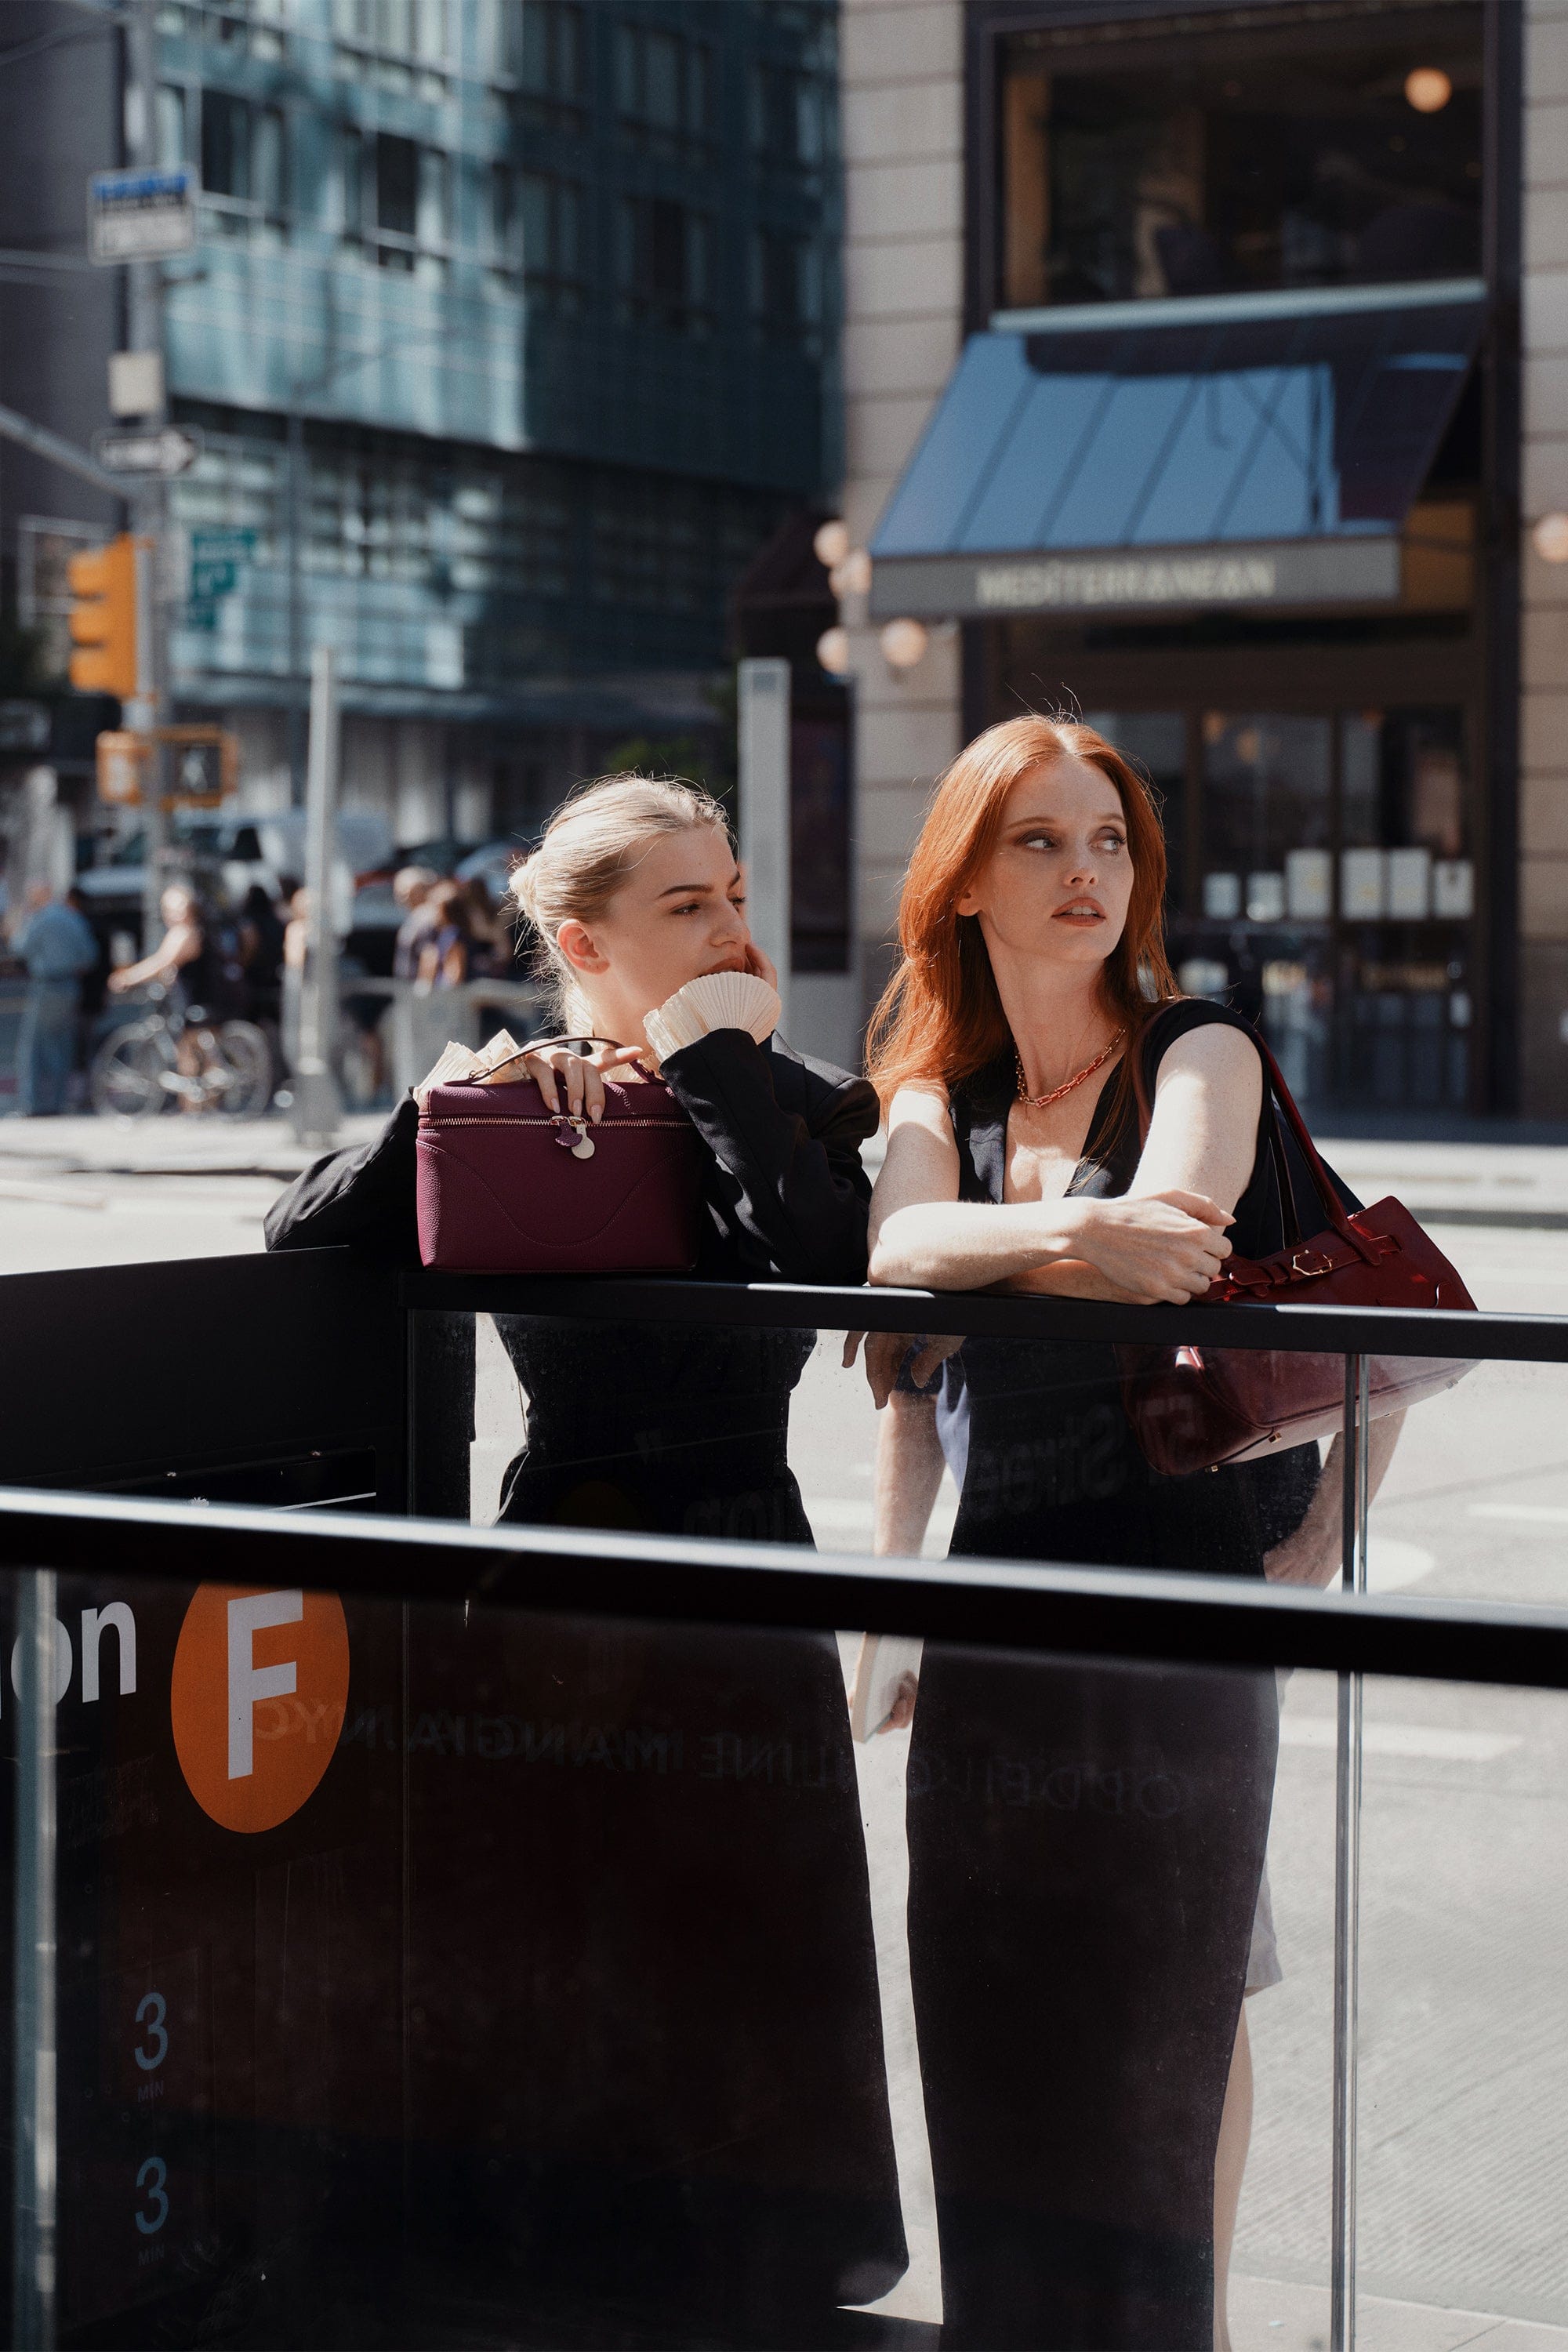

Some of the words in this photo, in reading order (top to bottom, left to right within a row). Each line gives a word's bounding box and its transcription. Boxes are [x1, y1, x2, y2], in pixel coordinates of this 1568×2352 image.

[977, 560, 1275, 606] MEDITERRANEAN
[0, 1601, 137, 1719] on
[227, 1589, 303, 1780] F
[134, 1991, 169, 2071] 3
[135, 2156, 169, 2234] 3
